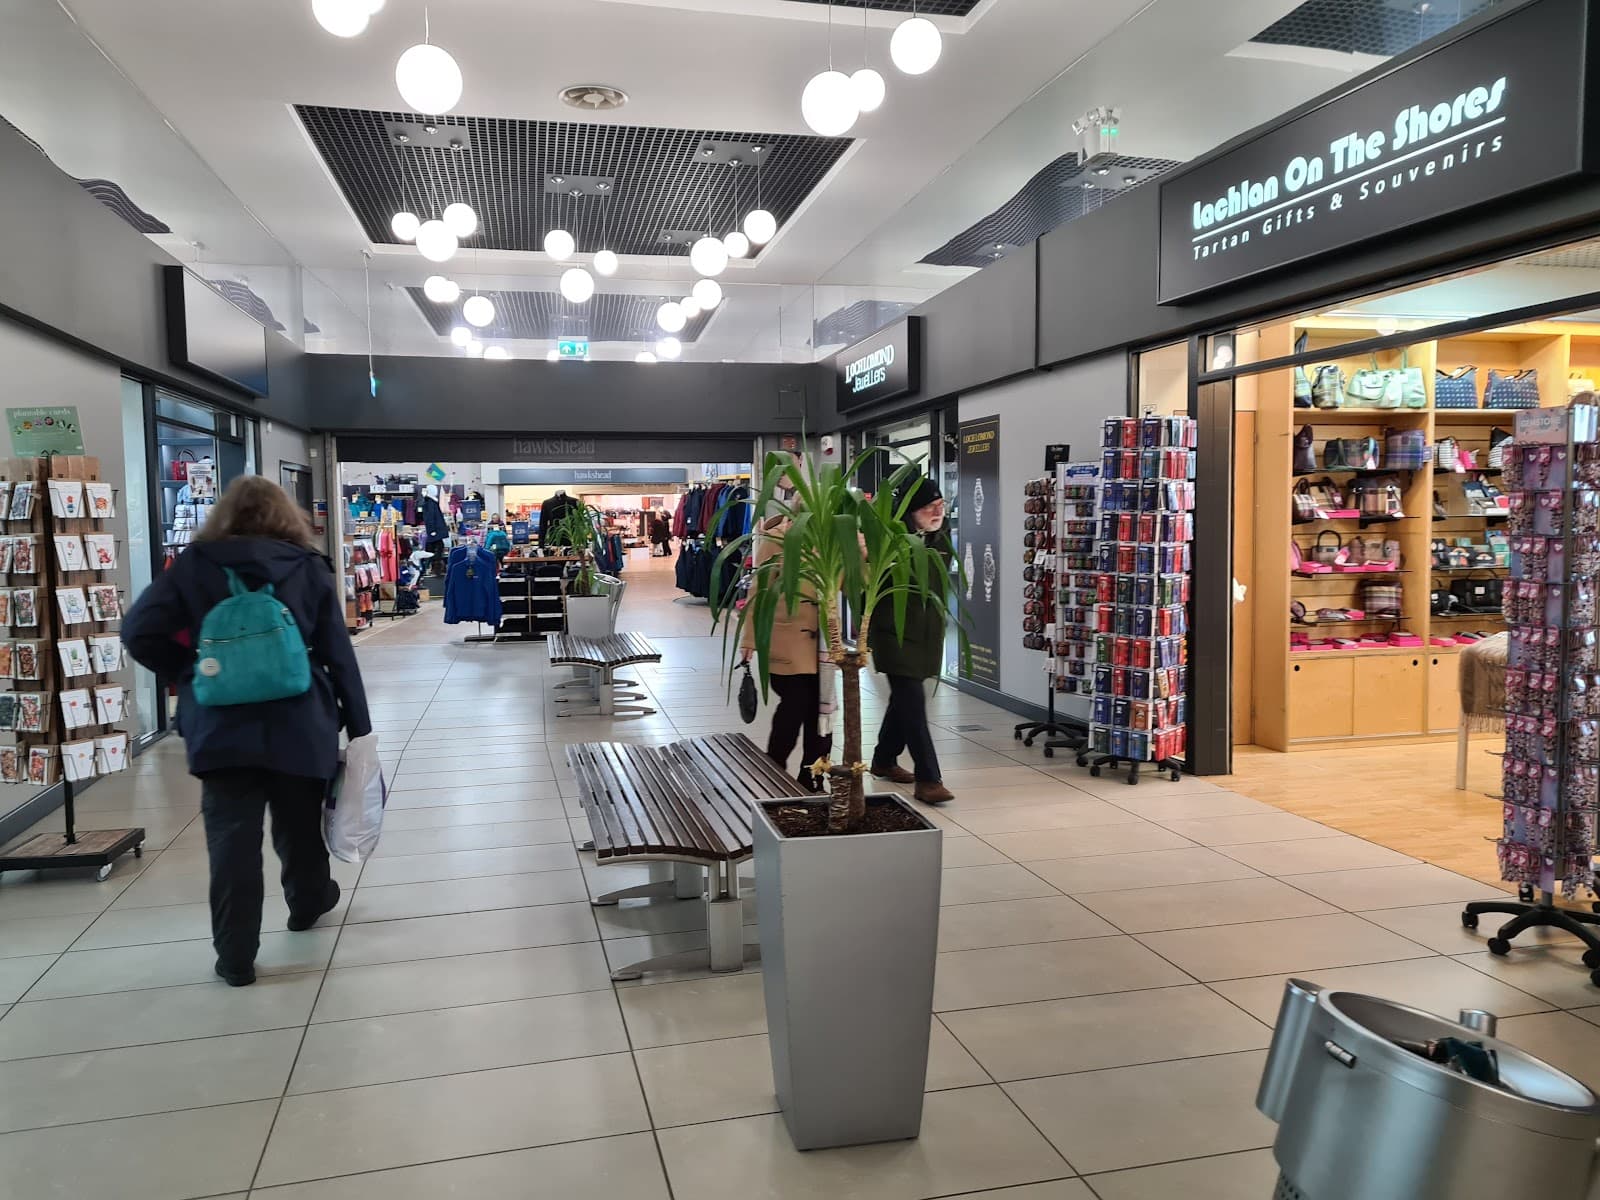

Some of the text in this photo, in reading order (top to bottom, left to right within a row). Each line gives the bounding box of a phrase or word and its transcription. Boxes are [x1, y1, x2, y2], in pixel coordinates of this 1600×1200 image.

[1193, 76, 1507, 230] Lachlan On The Shores
[1193, 135, 1503, 260] Tartan Gifts & Souvenirs
[513, 438, 595, 454] hawkshead
[574, 470, 612, 480] hawkshead
